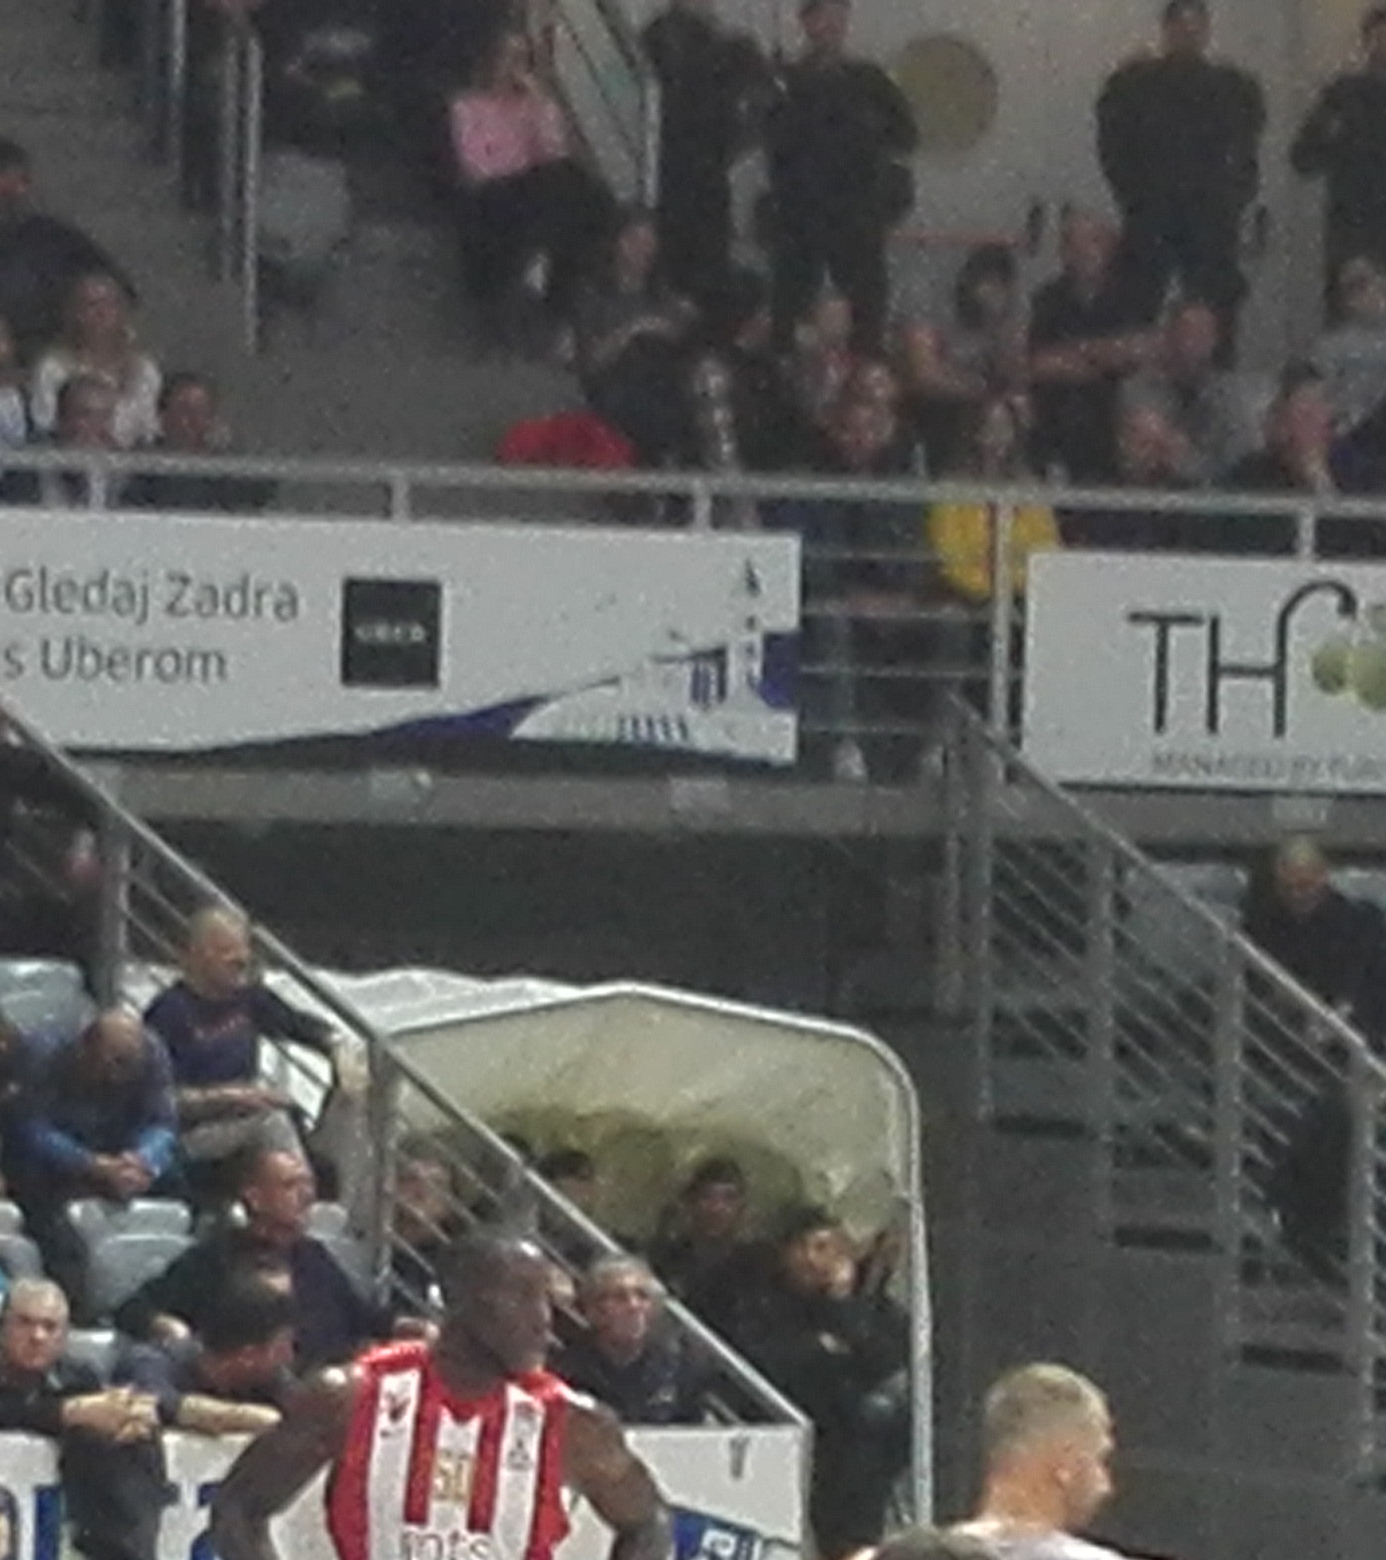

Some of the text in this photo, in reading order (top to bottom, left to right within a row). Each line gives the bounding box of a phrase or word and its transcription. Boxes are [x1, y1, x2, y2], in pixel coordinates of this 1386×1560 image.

[3, 566, 300, 625] Gledaj Zadra
[3, 637, 230, 684] s Uberom
